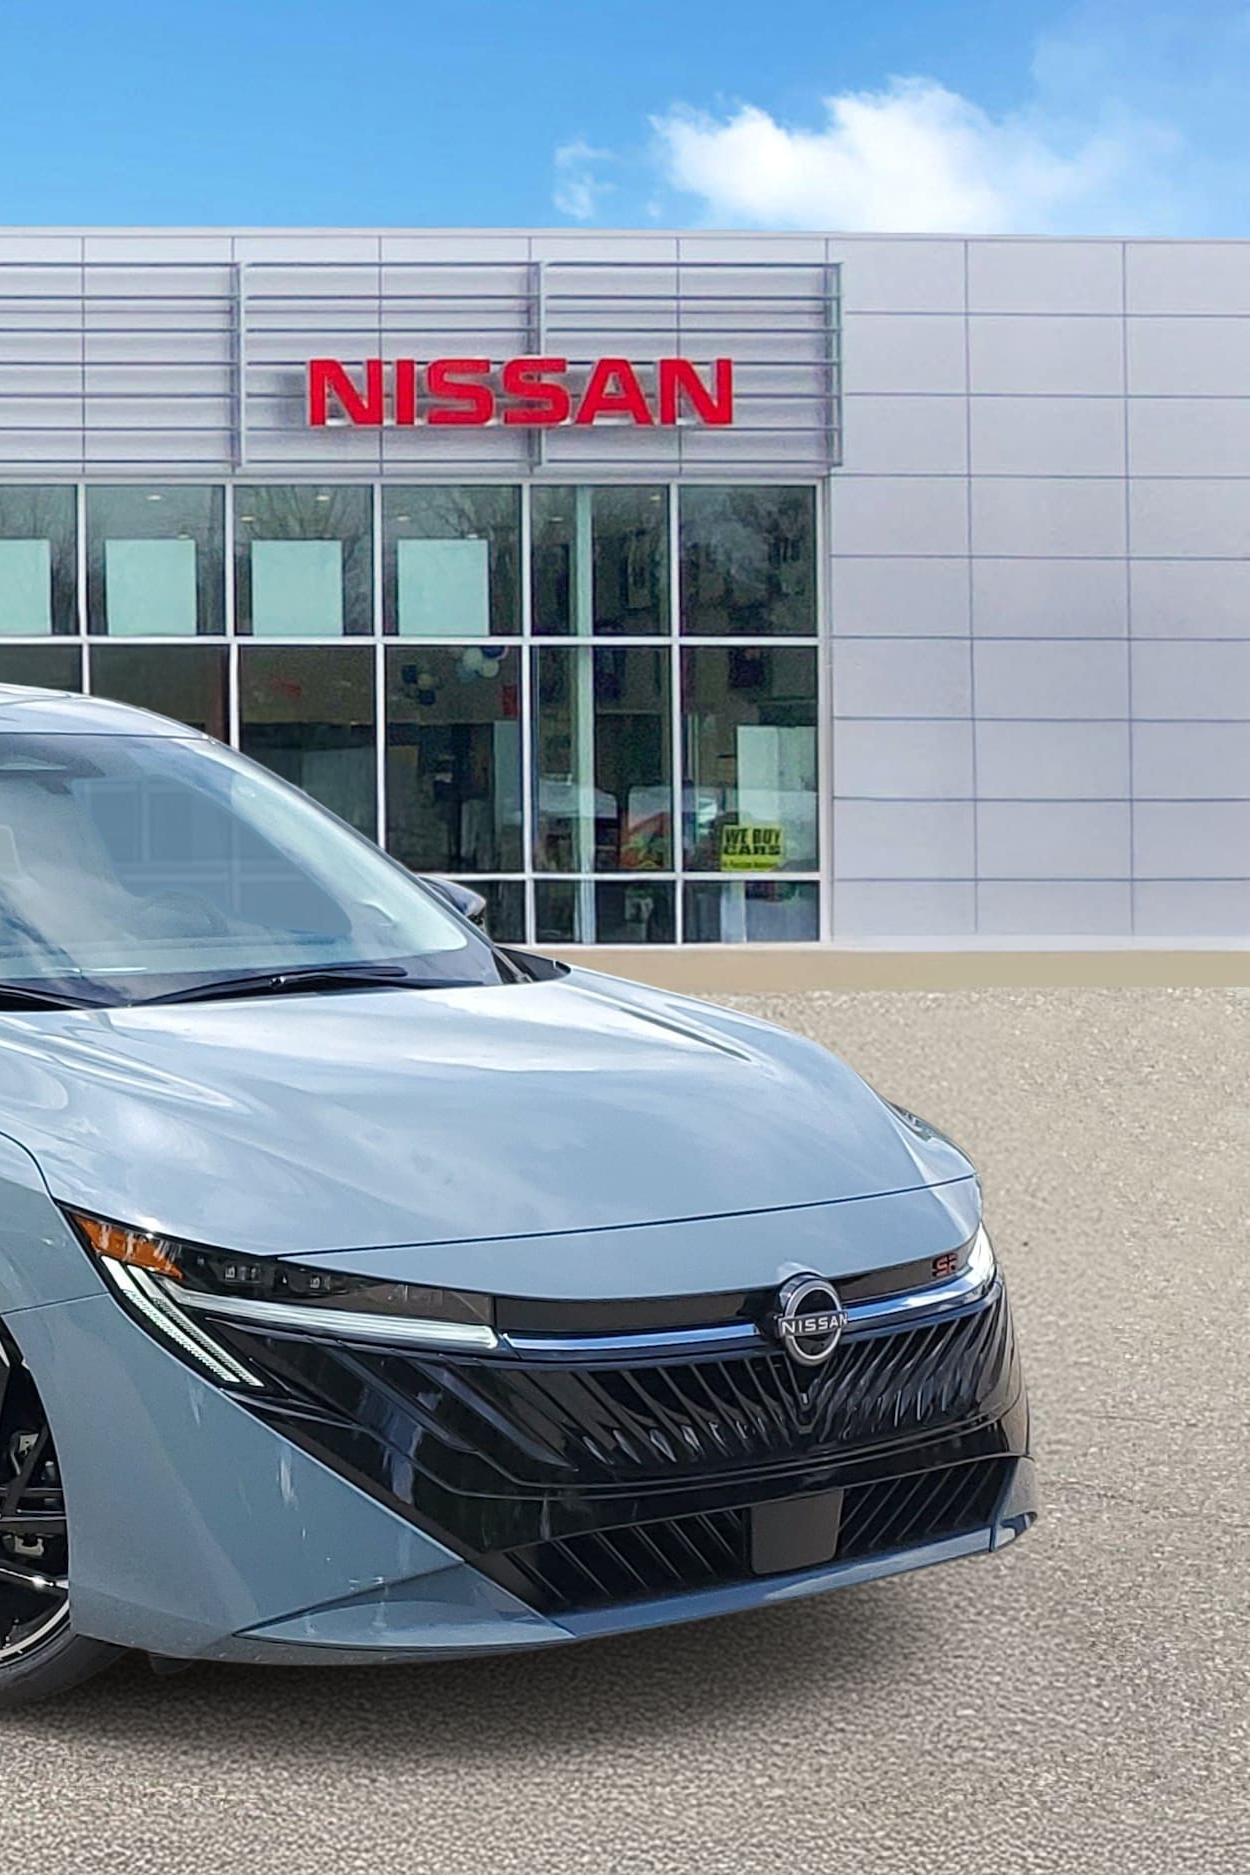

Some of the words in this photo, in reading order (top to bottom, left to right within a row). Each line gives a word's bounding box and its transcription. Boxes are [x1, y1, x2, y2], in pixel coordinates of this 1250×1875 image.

[307, 358, 733, 426] NISSAN
[725, 828, 748, 844] WE
[723, 844, 780, 855] CARS
[781, 1313, 848, 1335] NISSAN
